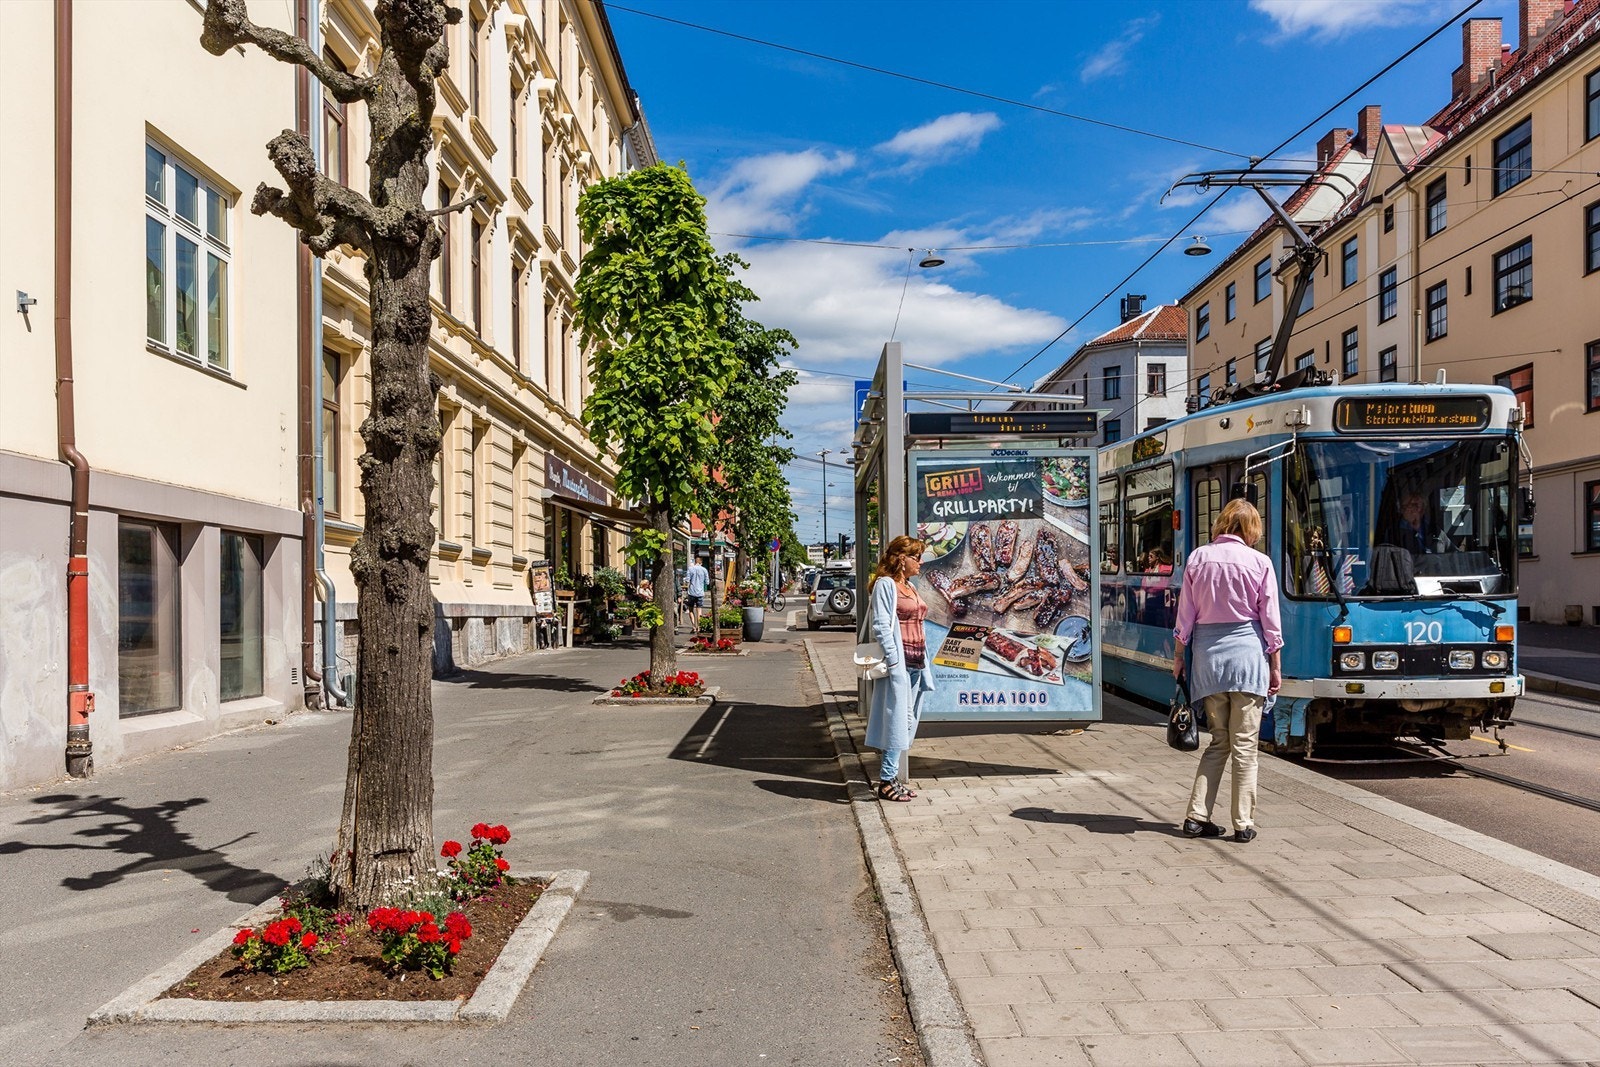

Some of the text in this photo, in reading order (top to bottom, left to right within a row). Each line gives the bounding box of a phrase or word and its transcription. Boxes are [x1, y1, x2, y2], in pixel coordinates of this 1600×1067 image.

[929, 473, 980, 491] GRILL
[987, 471, 1037, 484] Velkommen
[936, 487, 973, 497] REMA 1000
[1007, 481, 1019, 492] til
[933, 498, 1034, 517] GRILLPARTY!
[1403, 621, 1443, 644] 120
[945, 638, 962, 646] BABY
[942, 644, 960, 653] BACK
[960, 647, 976, 656] RIBS
[959, 692, 1047, 704] REMA 1000
